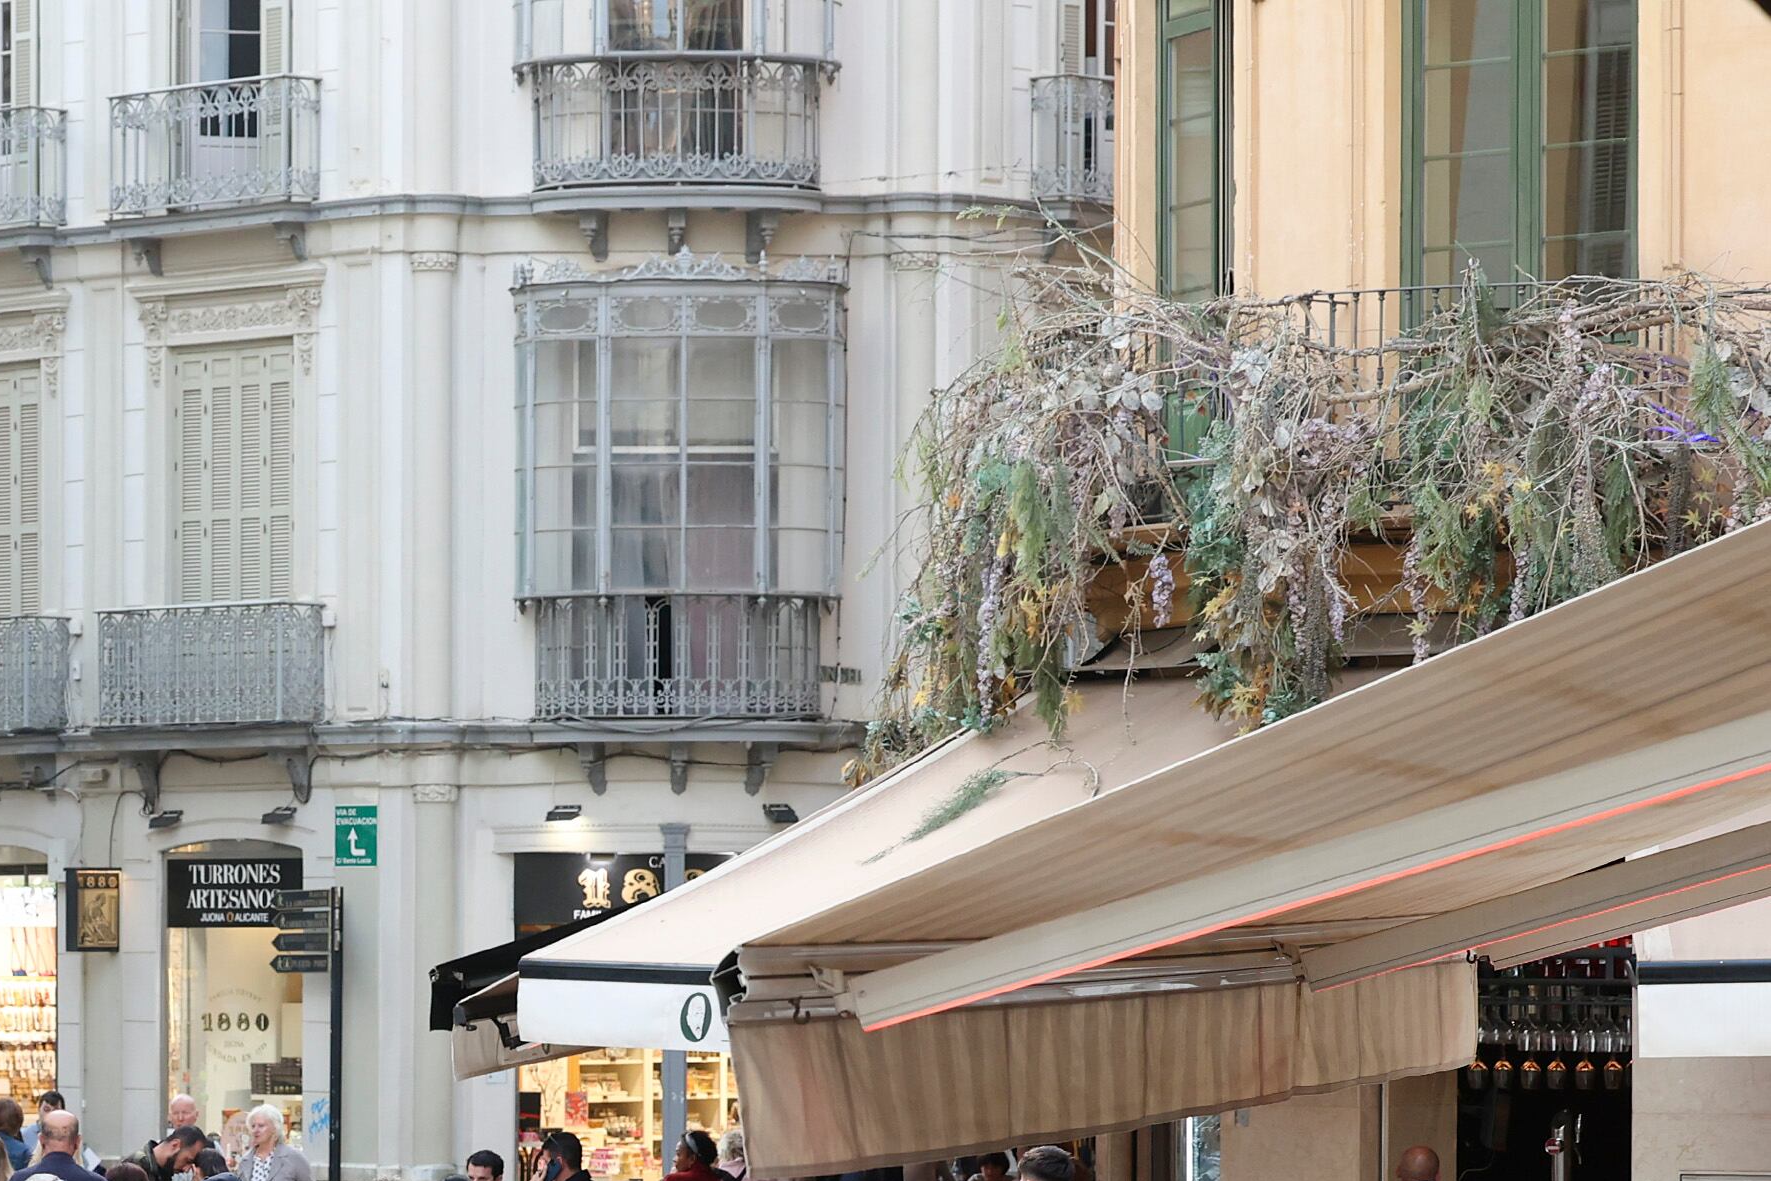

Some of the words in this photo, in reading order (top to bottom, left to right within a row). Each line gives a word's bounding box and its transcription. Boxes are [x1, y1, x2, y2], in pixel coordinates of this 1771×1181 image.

[188, 863, 280, 884] TURRONES
[234, 912, 269, 923] ALICANTE
[201, 1012, 270, 1032] 1880
